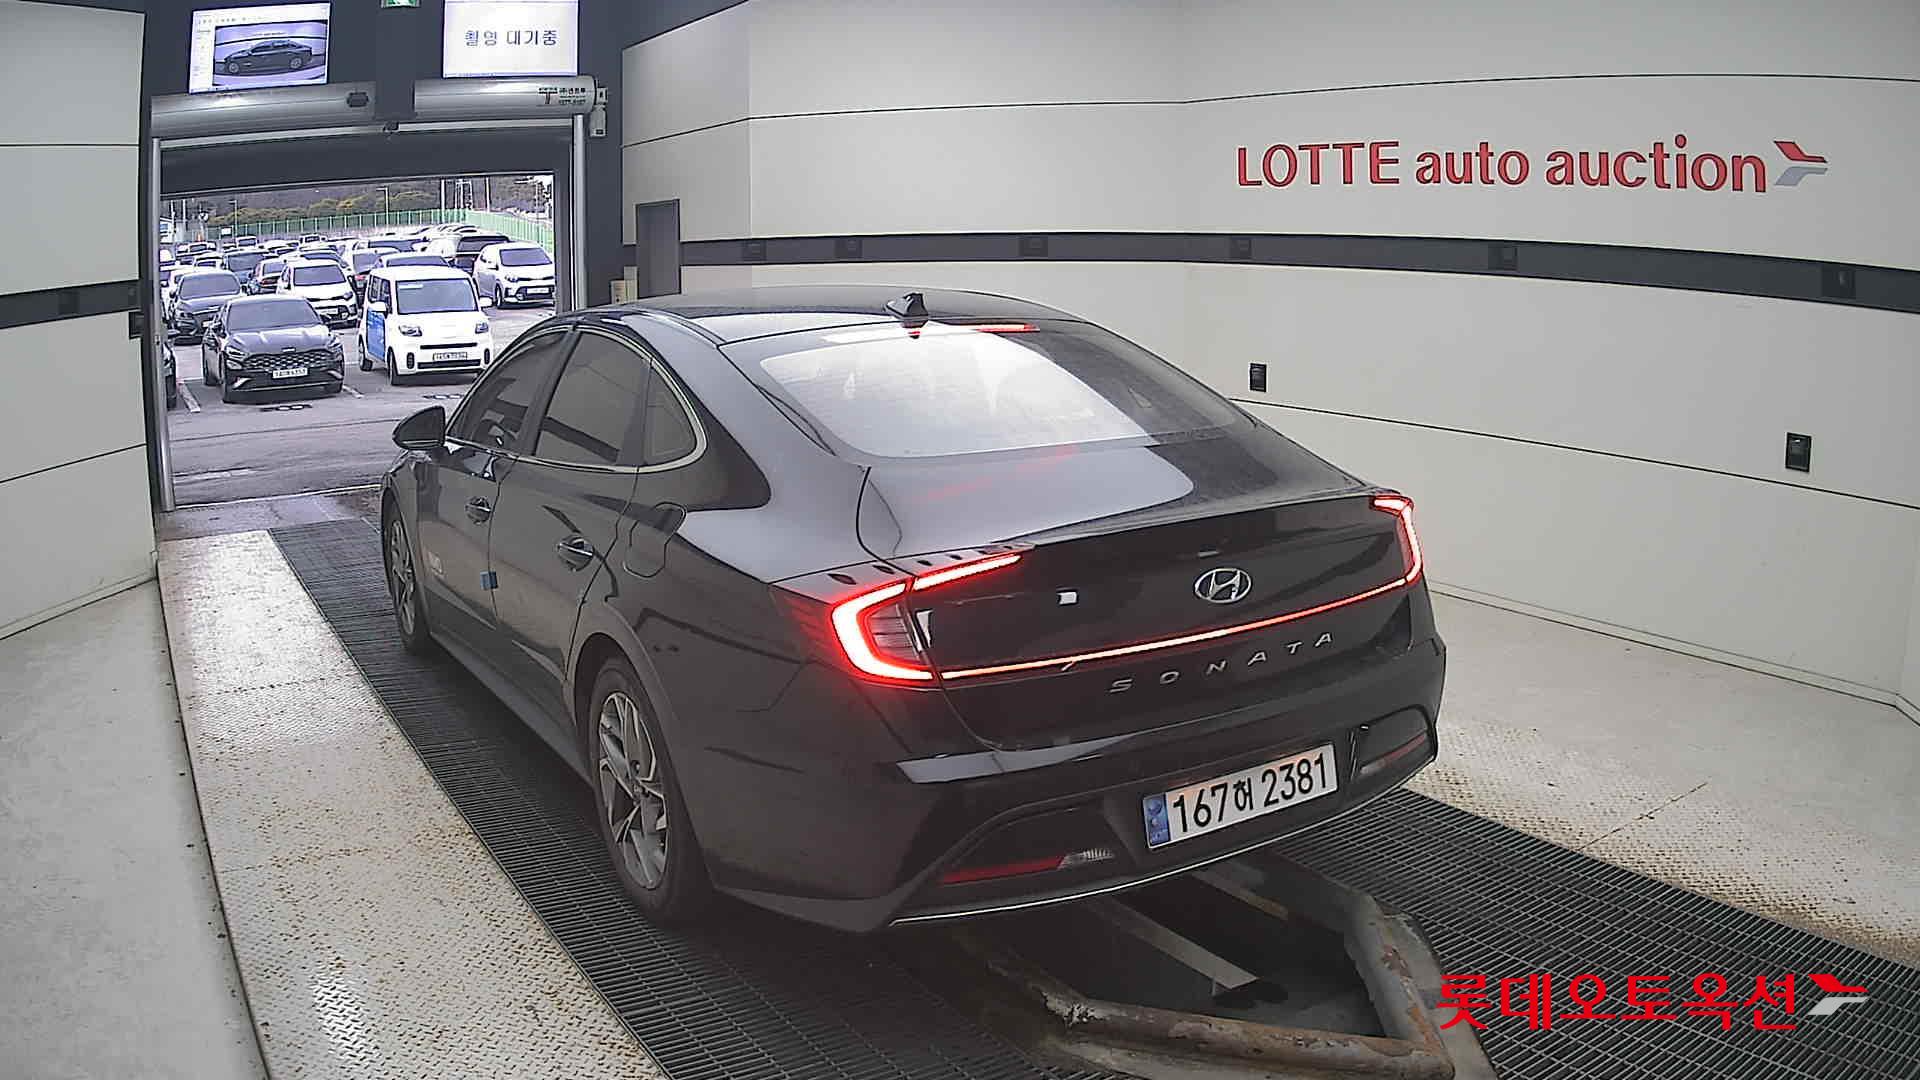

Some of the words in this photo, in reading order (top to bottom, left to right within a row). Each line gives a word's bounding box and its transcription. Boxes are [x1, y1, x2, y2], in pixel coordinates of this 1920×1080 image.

[506, 30, 557, 46] 대기중
[1238, 141, 1400, 187] LOTTE
[1416, 142, 1530, 184] auto
[1545, 134, 1768, 193] auction
[1109, 632, 1333, 693] SONATA
[1173, 777, 1254, 833] 167허
[1261, 753, 1327, 807] 2381
